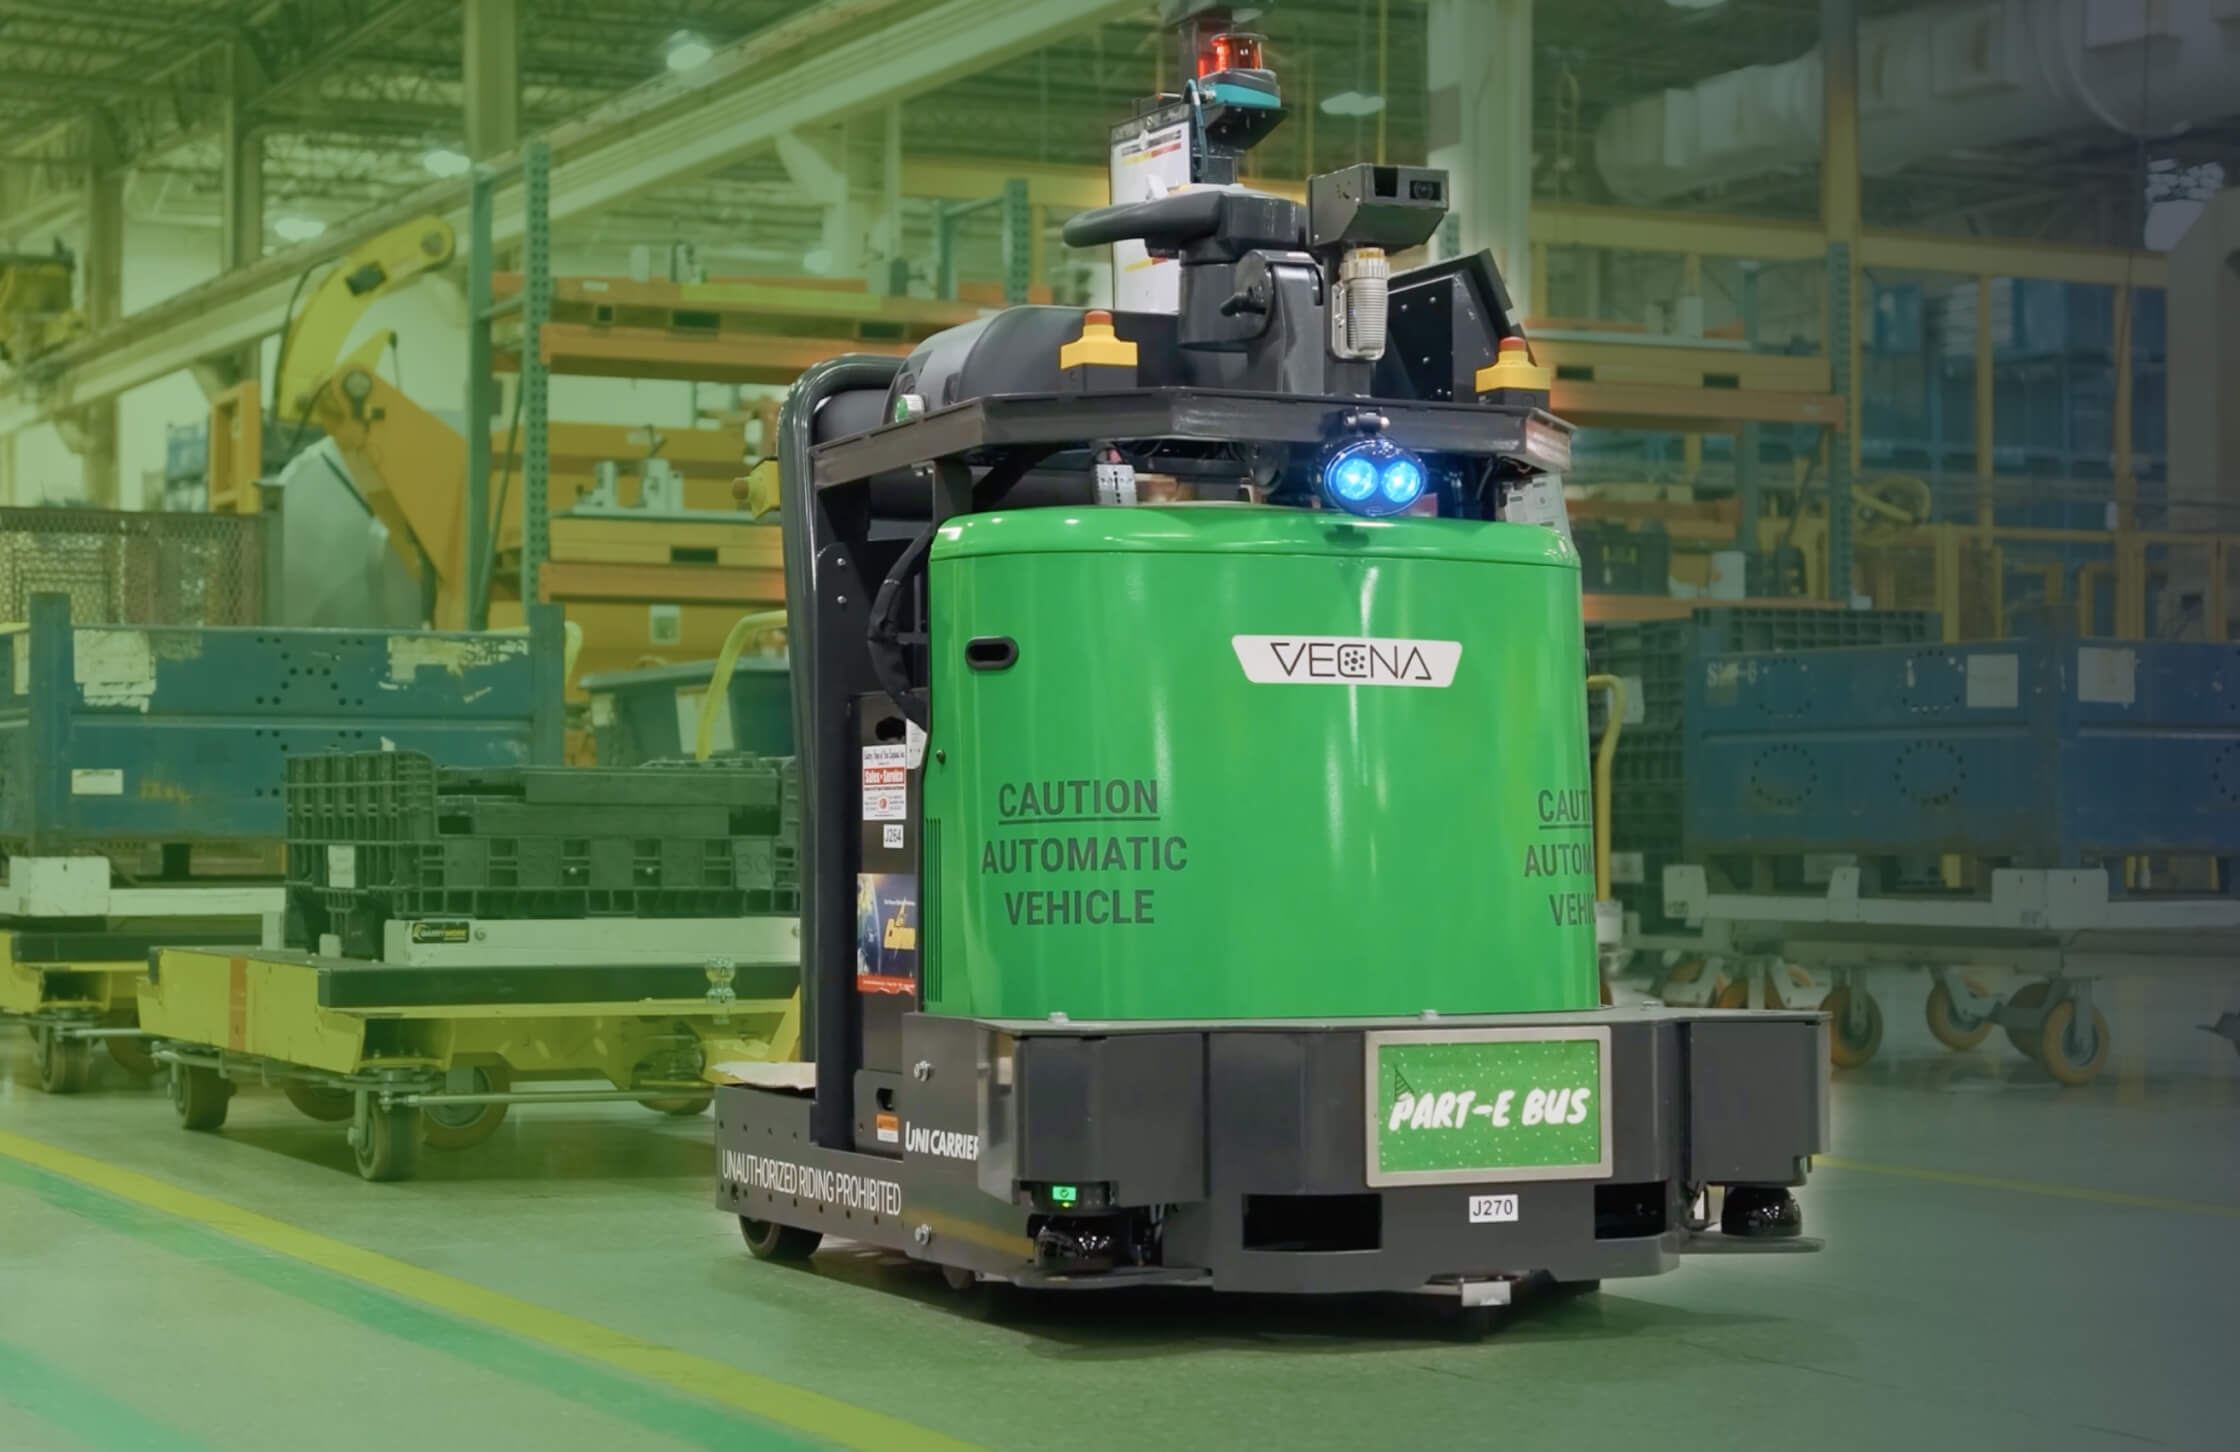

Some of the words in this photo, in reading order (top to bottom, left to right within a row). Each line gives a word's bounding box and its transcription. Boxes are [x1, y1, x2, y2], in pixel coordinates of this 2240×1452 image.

[1270, 642, 1432, 681] VECNA
[999, 780, 1159, 817] CAUTION
[982, 836, 1188, 874] AUTOMATIC
[1004, 889, 1155, 926] VEHICLE
[1388, 1089, 1515, 1131] PART-E
[1521, 1087, 1591, 1126] BUS
[721, 1149, 798, 1195] UNAUTHORIZED
[799, 1165, 834, 1203] RIDING
[836, 1172, 902, 1217] PROHIBITED
[1473, 1199, 1514, 1217] J270
